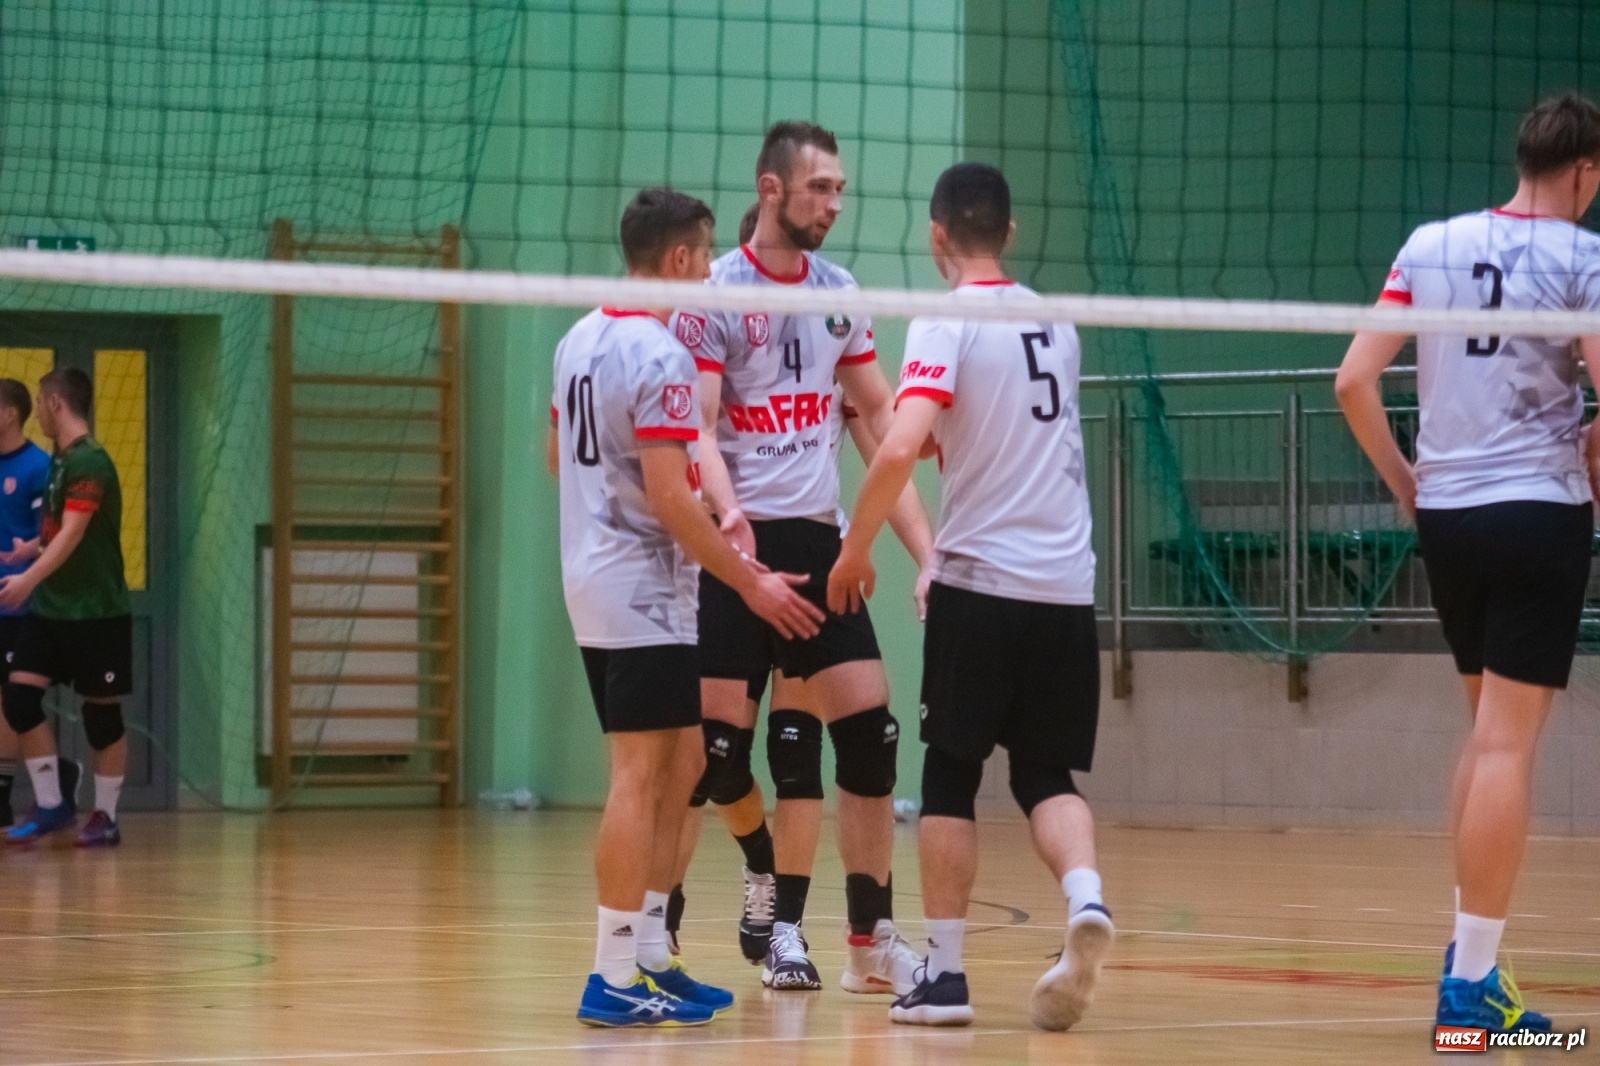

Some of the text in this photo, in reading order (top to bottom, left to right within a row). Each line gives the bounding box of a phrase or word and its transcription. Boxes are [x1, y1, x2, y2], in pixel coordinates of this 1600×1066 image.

[1466, 262, 1503, 358] 3
[784, 338, 802, 384] 4
[1020, 332, 1060, 424] 5
[566, 374, 600, 468] 10
[756, 443, 798, 457] GRUPA
